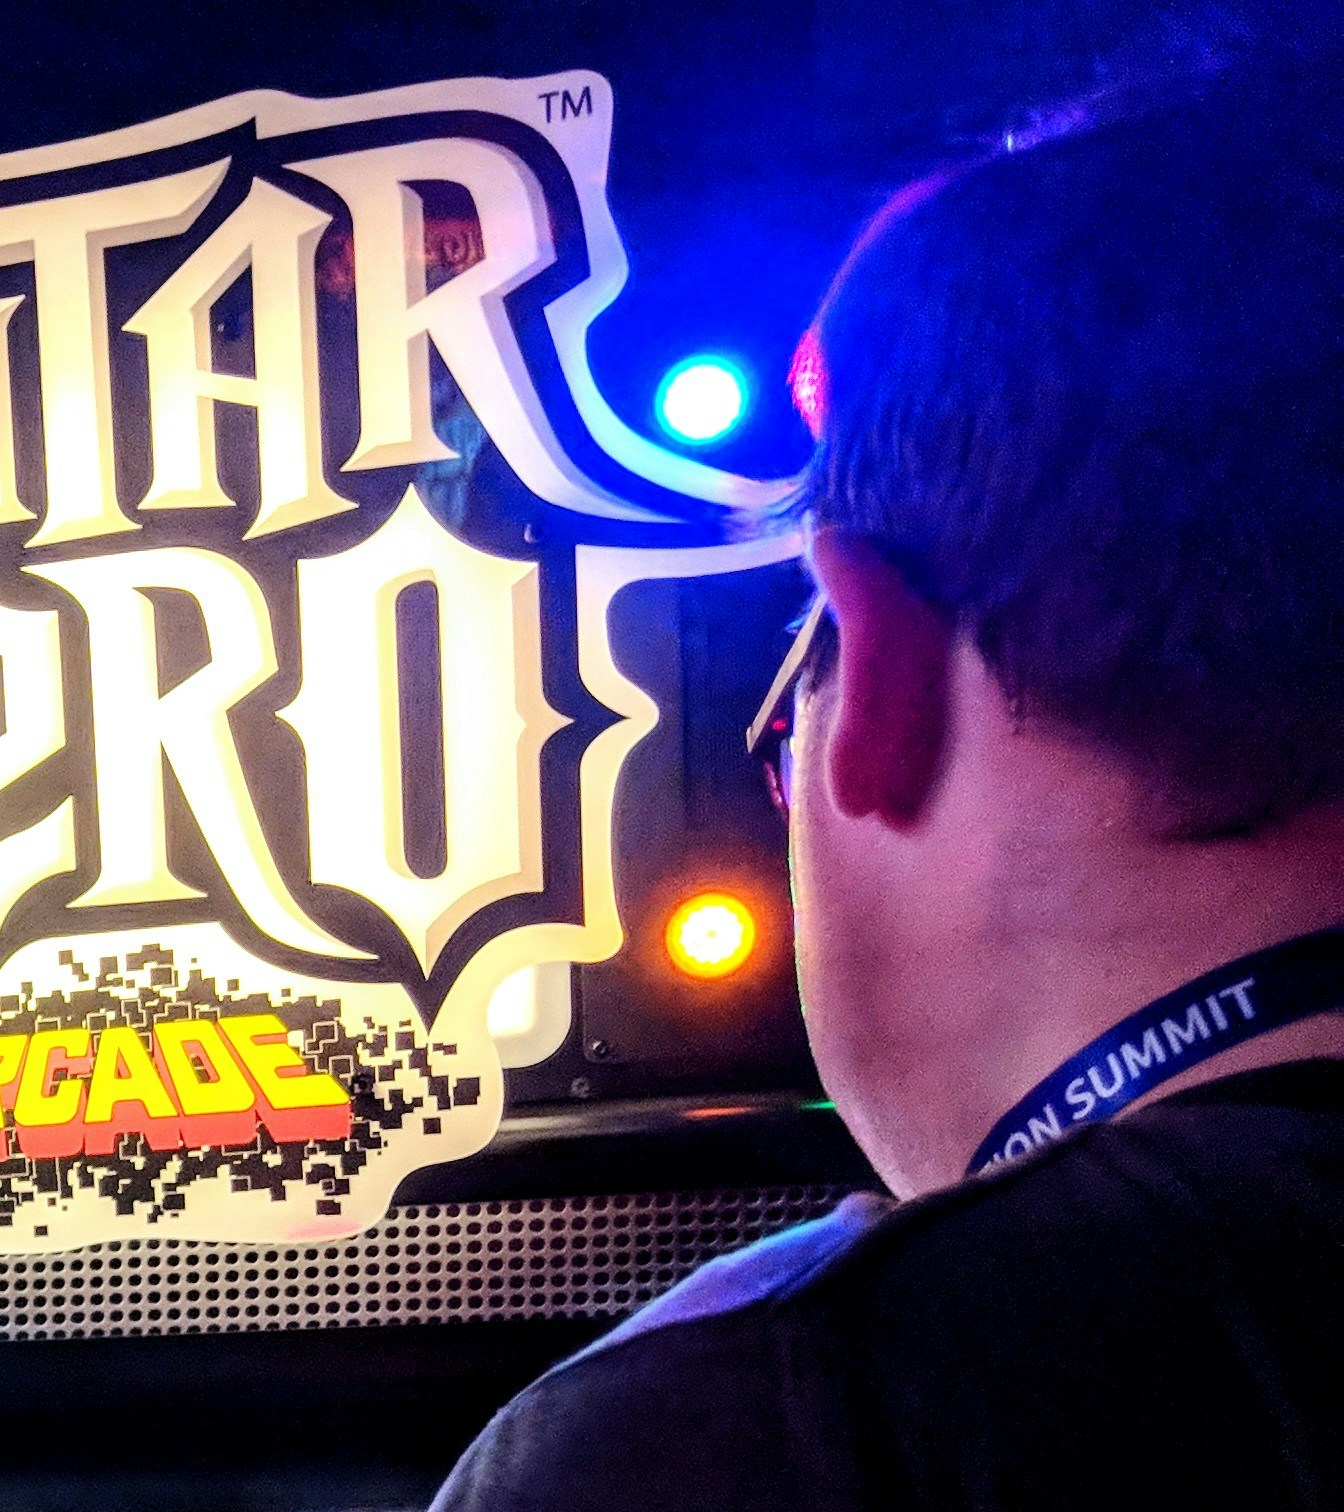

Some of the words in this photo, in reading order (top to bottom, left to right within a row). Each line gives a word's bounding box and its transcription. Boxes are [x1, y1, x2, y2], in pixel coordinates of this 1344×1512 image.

[538, 86, 593, 123] TM
[976, 1102, 1063, 1177] ON
[1064, 977, 1256, 1121] SUMMIT
